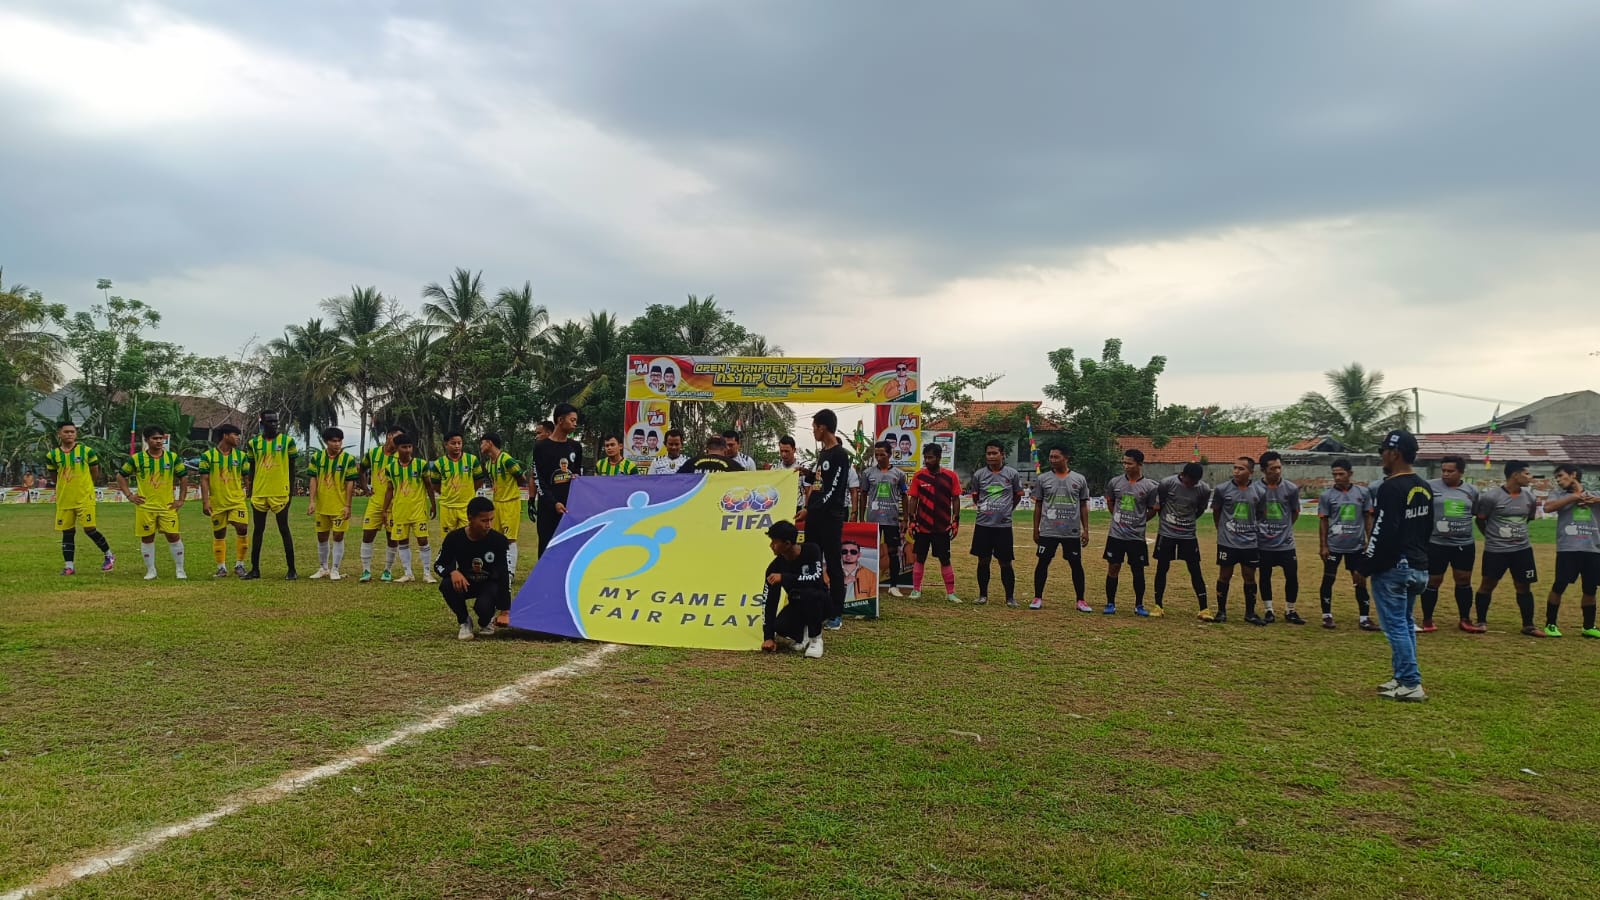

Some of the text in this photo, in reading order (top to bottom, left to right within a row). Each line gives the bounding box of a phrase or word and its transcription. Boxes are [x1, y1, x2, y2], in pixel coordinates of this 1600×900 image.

[695, 363, 864, 374] OPEN TURNAMEN SEPAK BOLA
[766, 373, 797, 384] CUP
[801, 374, 842, 384] 2024
[650, 415, 664, 424] AA
[903, 419, 917, 428] AA
[720, 513, 774, 531] FIFA
[599, 586, 764, 607] MY GAME IS
[589, 604, 663, 623] FAIR
[680, 613, 761, 627] PLAY
